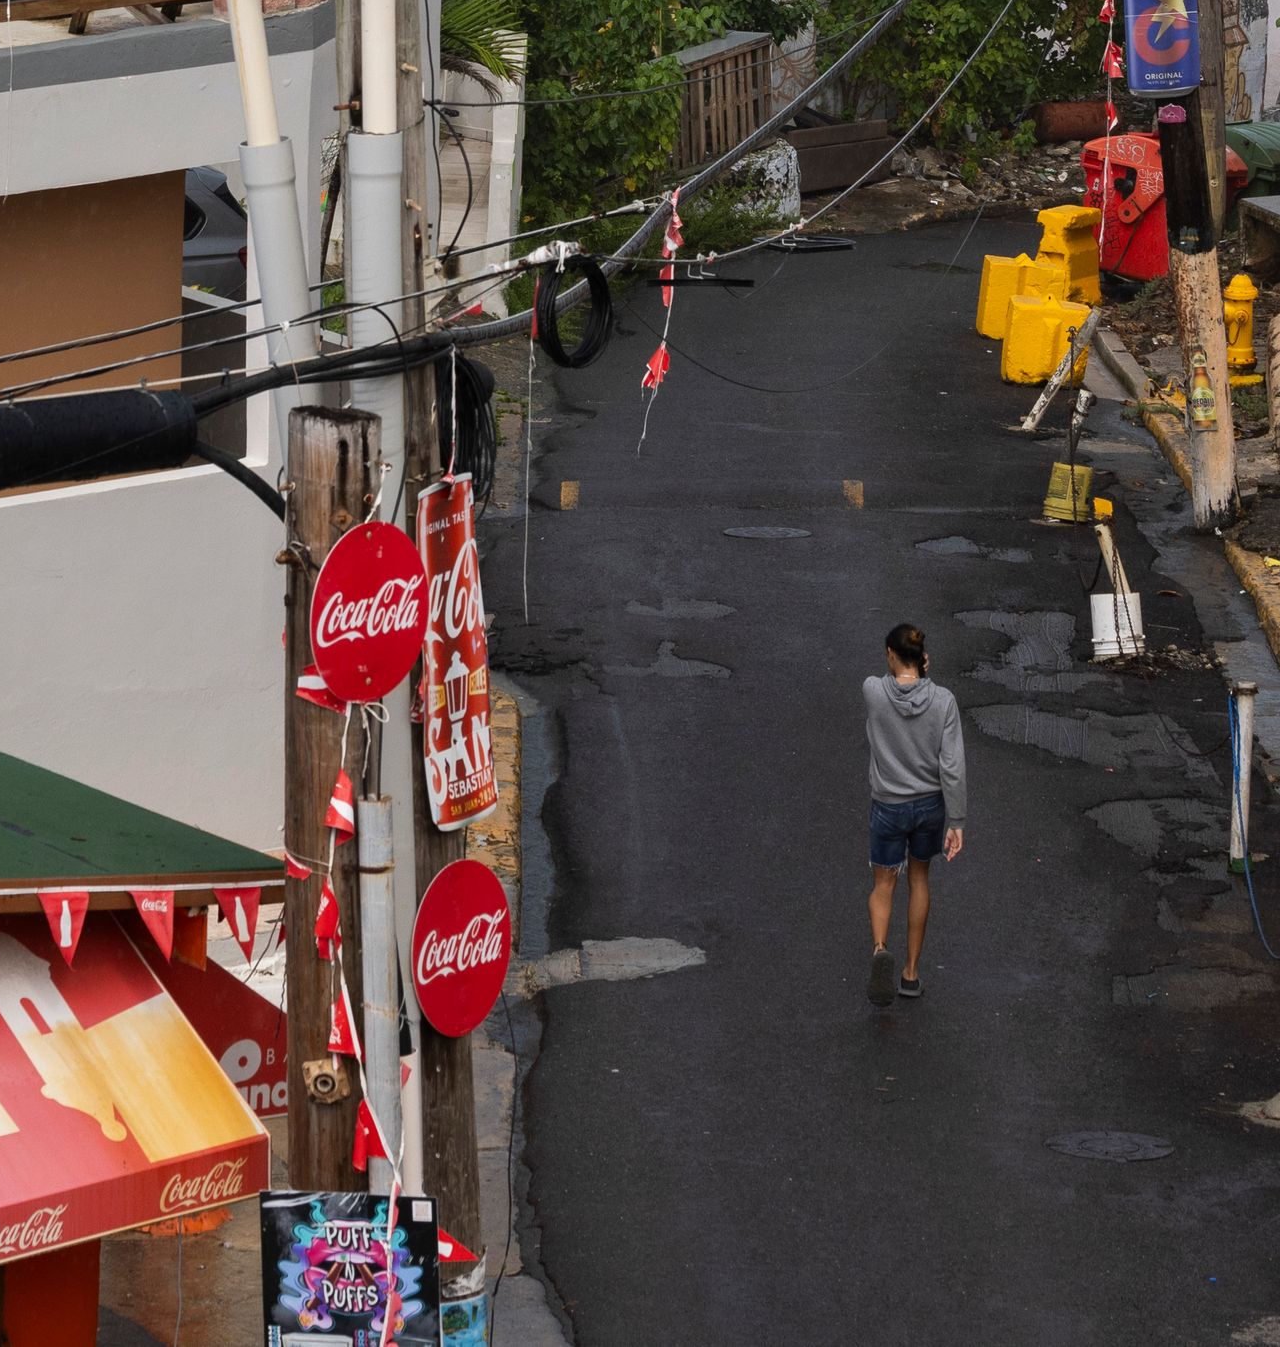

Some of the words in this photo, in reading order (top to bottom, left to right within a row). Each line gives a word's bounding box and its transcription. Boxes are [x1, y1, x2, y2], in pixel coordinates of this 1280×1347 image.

[1144, 72, 1183, 80] ORIGINAL
[316, 573, 425, 648] Coca-Cola
[417, 907, 507, 985] Coca-Cola
[160, 1157, 248, 1213] Coca-Cola
[322, 1280, 379, 1313] PUFFS
